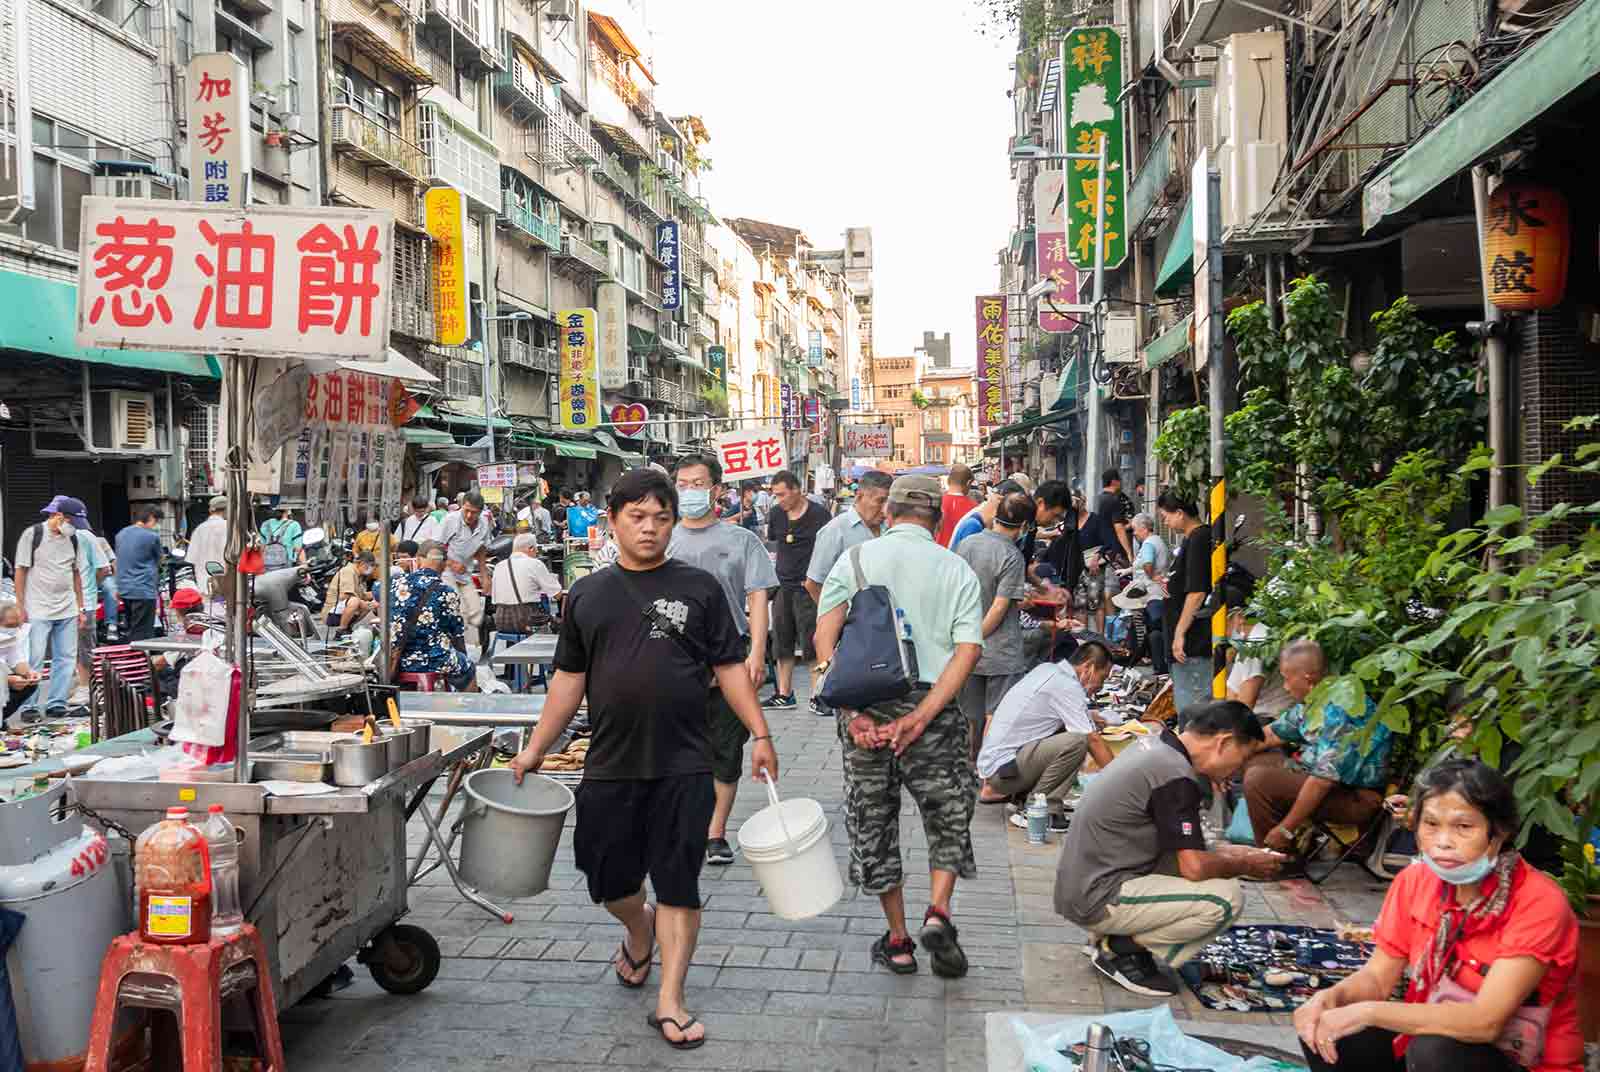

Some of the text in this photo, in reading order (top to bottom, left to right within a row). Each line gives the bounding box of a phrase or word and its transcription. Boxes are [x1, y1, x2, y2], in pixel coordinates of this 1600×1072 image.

[90, 216, 381, 336] 葱油餅
[1488, 191, 1545, 293] 水餃
[720, 437, 782, 474] 豆花
